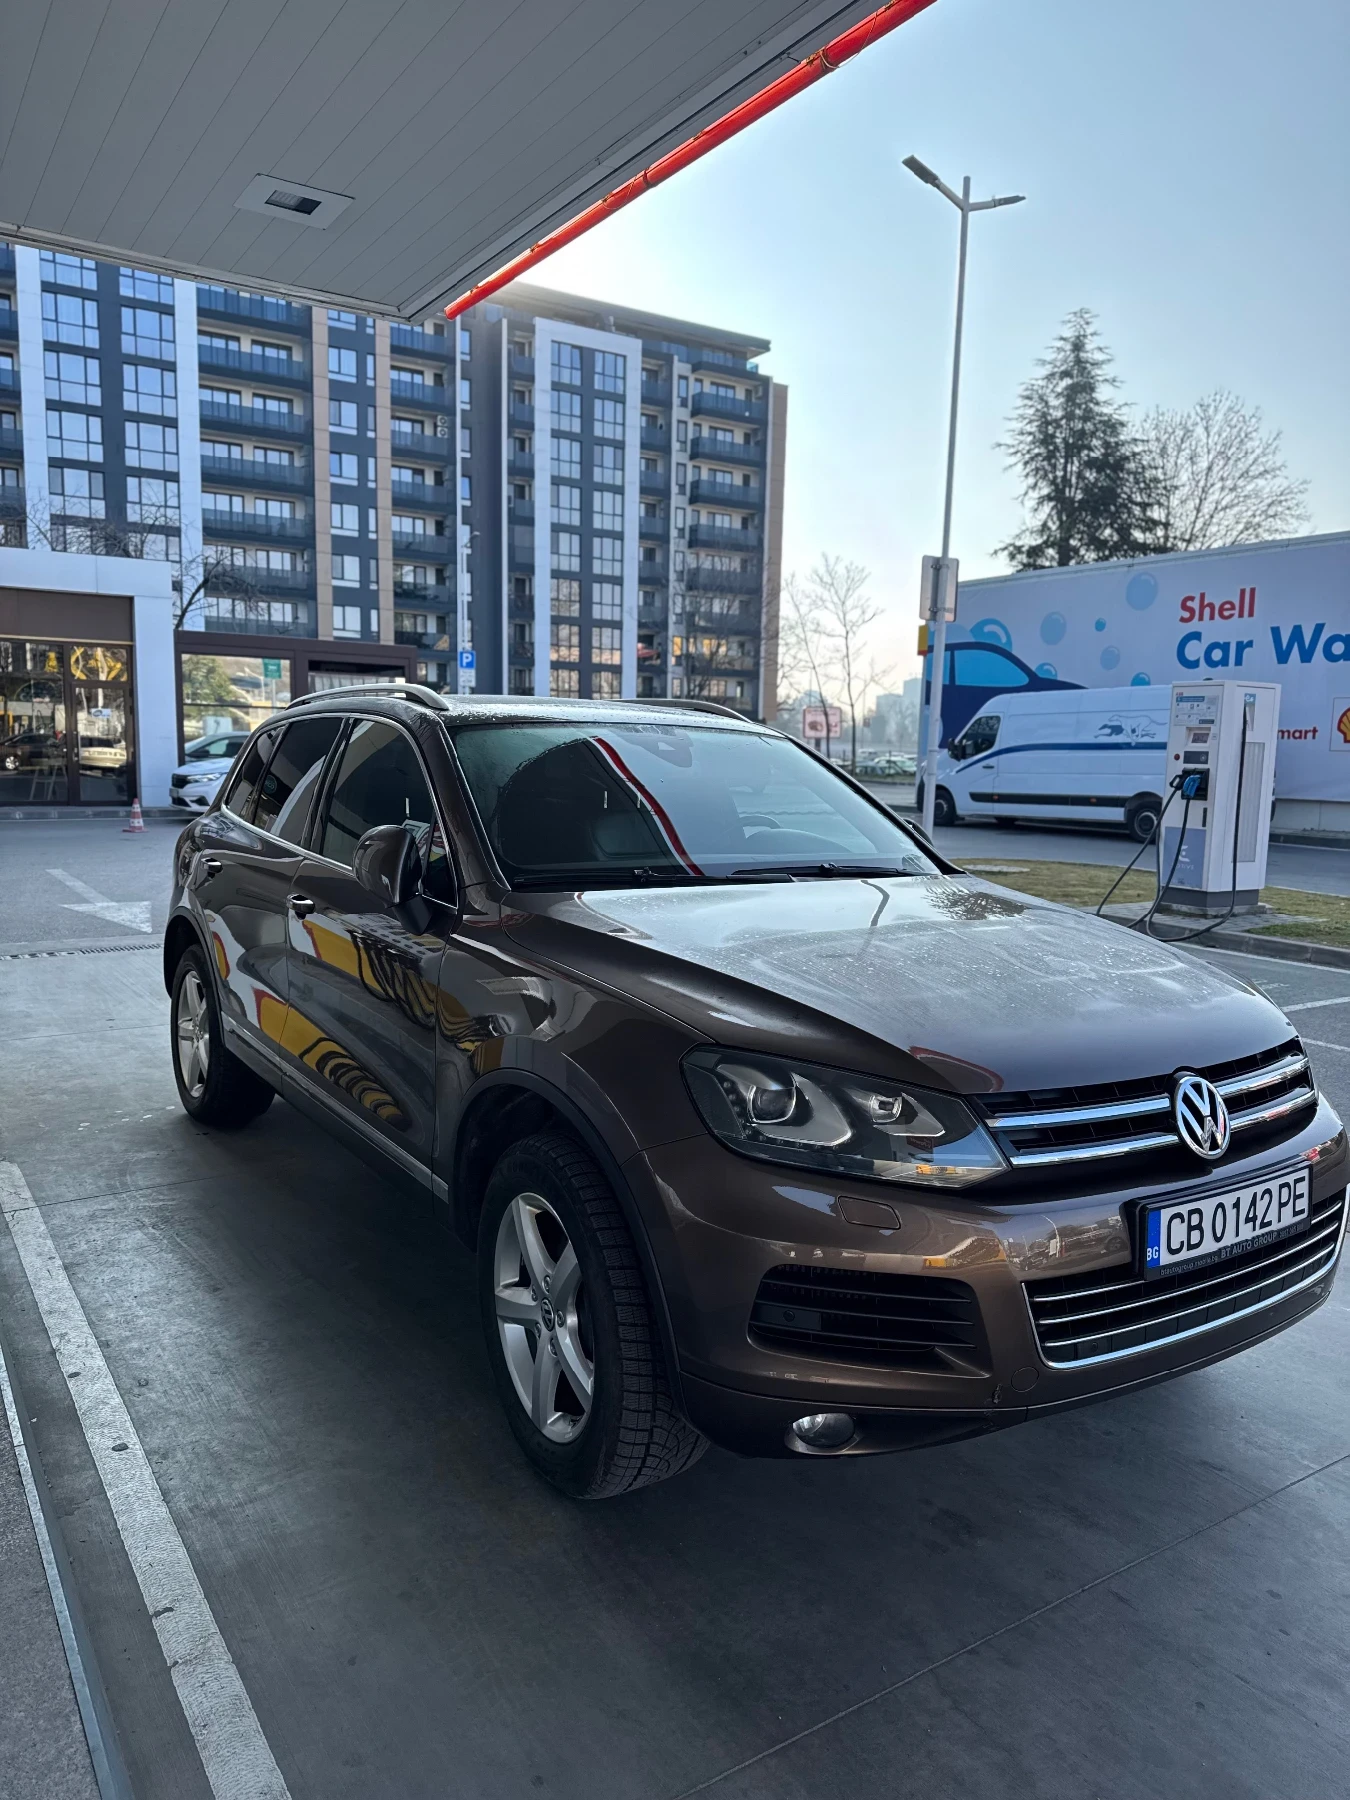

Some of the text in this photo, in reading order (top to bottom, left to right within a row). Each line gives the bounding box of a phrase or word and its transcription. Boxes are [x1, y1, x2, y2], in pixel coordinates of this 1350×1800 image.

[1179, 587, 1256, 623] Shell
[1176, 622, 1350, 669] Car Wa
[462, 653, 473, 667] P
[1146, 1246, 1159, 1261] BG
[1221, 1247, 1231, 1258] BT
[1231, 1240, 1252, 1255] AUTO
[1253, 1232, 1277, 1248] GROUP
